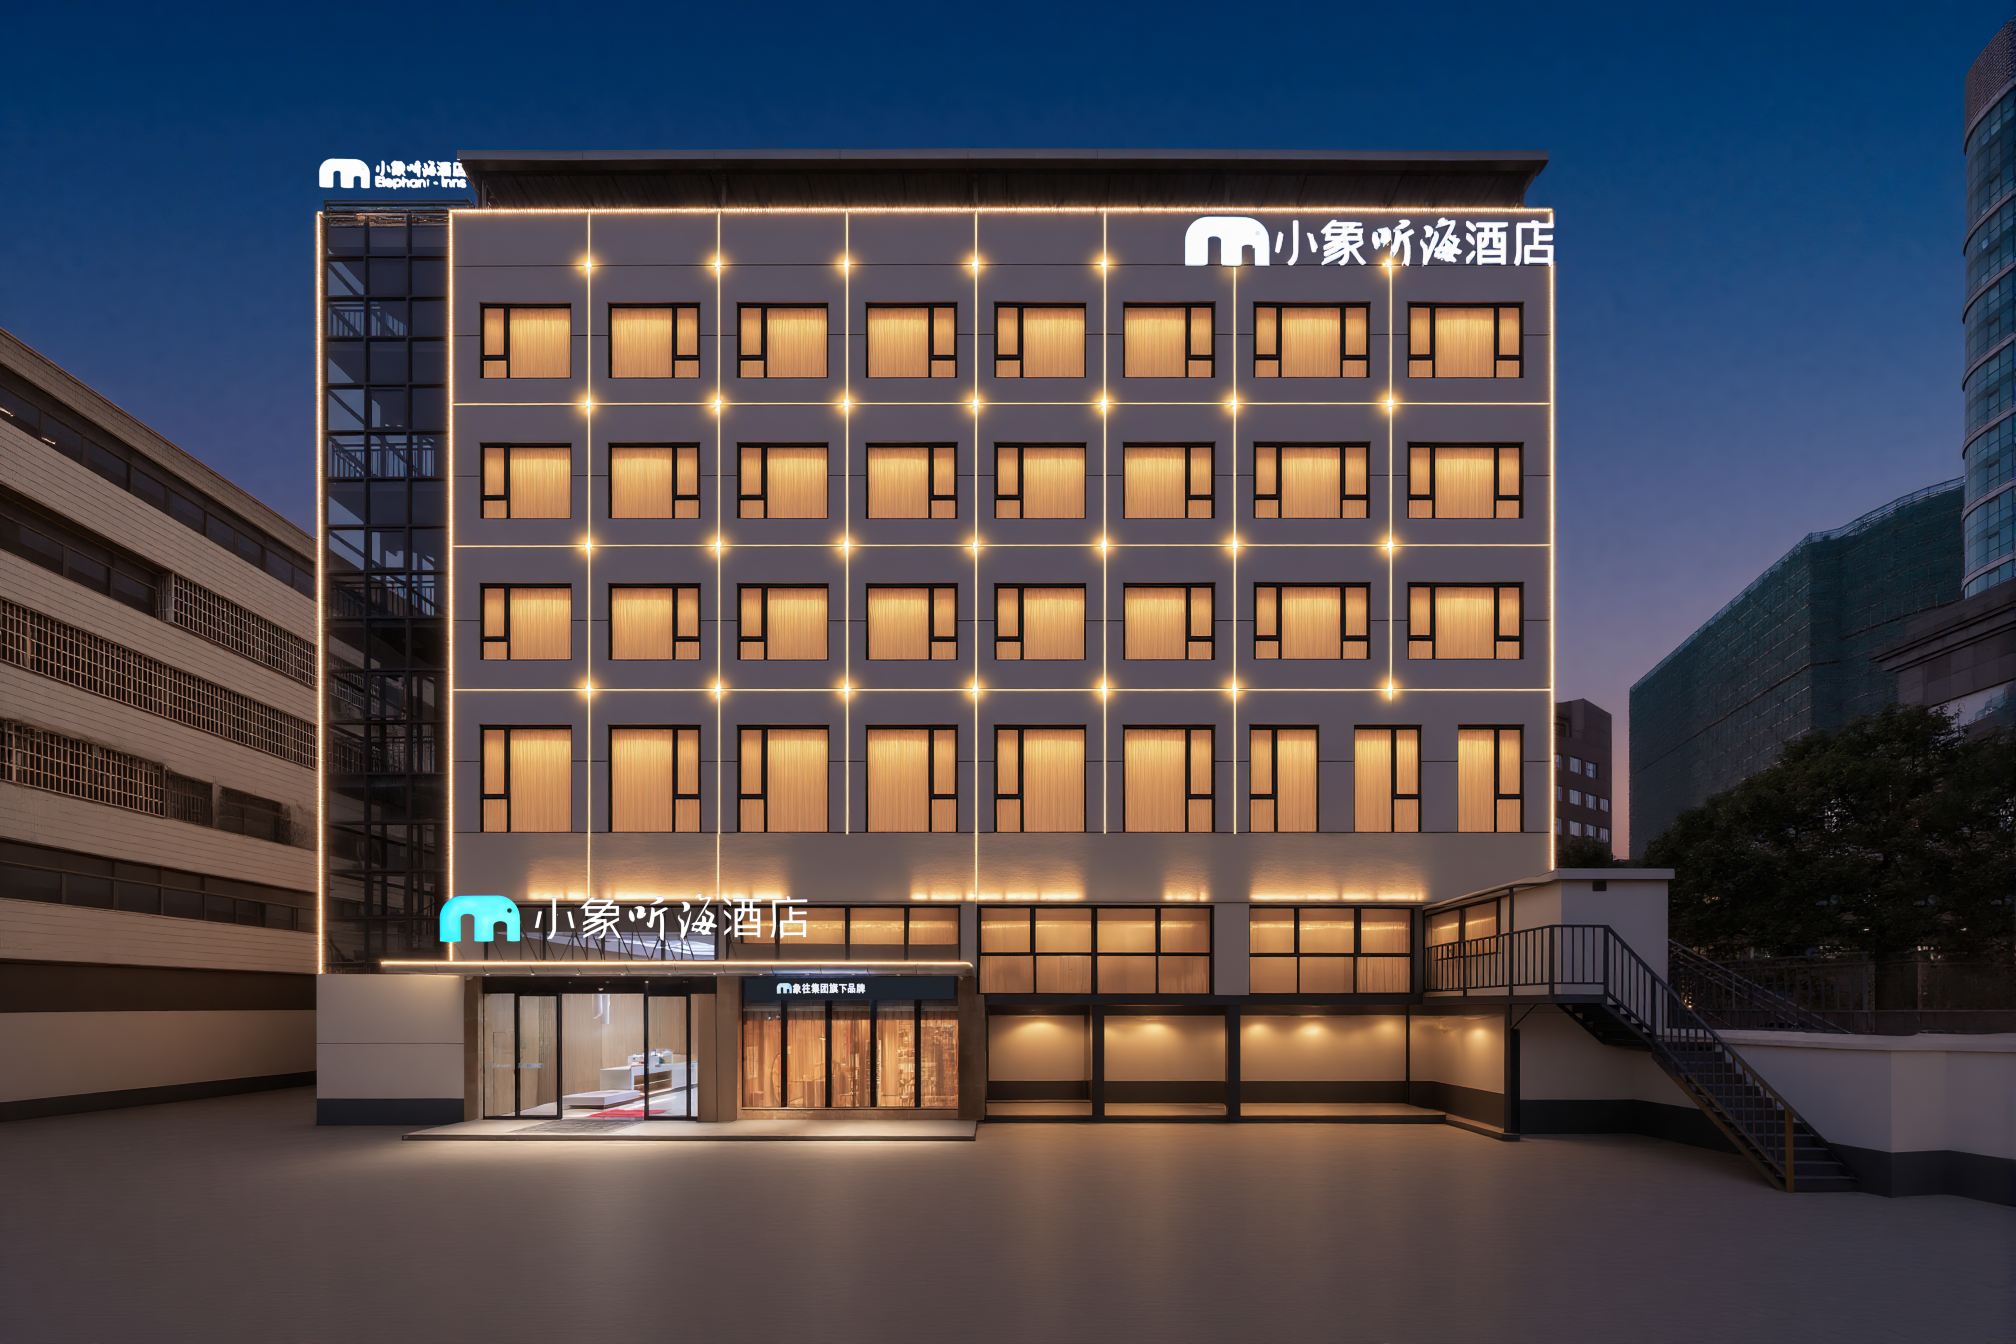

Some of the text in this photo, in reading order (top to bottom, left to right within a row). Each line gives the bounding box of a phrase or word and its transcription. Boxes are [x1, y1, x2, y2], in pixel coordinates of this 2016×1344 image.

[1274, 218, 1555, 267] 小象听海酒店
[534, 893, 809, 942] 小象听海酒店
